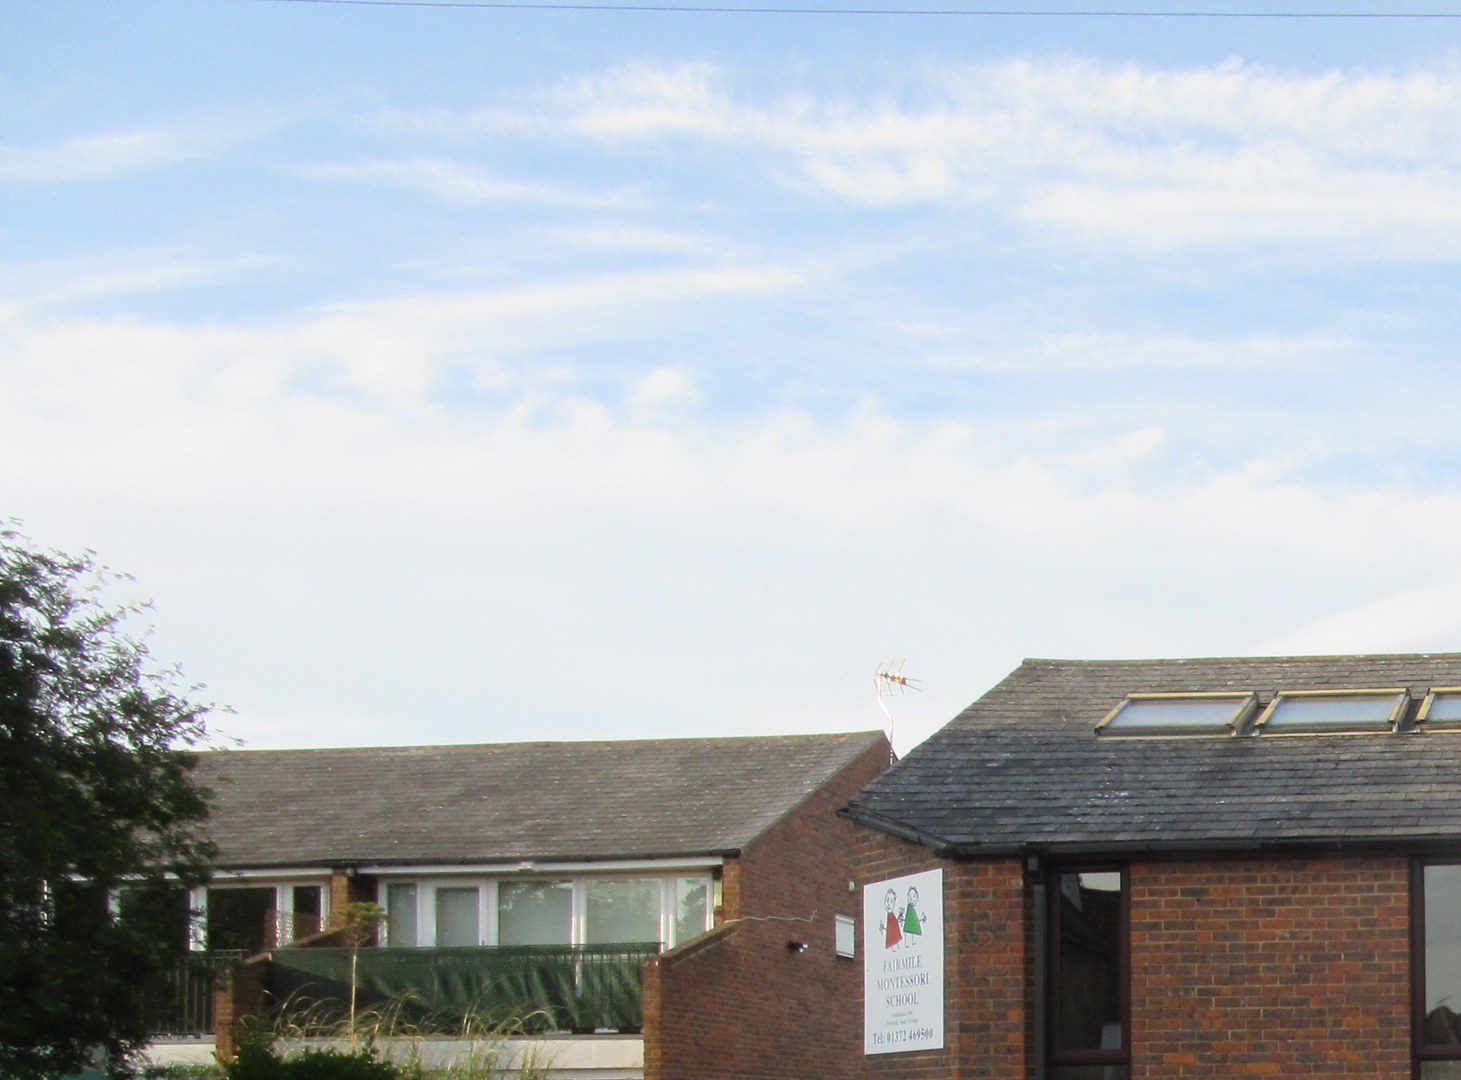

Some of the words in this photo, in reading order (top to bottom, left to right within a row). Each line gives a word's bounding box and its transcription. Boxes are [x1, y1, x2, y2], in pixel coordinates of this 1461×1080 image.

[883, 955, 922, 972] FAIRMILE
[876, 972, 929, 991] MONTESSORI
[885, 992, 919, 1009] SCHOOL
[873, 1032, 886, 1045] Tel:
[886, 1030, 907, 1044] 01372
